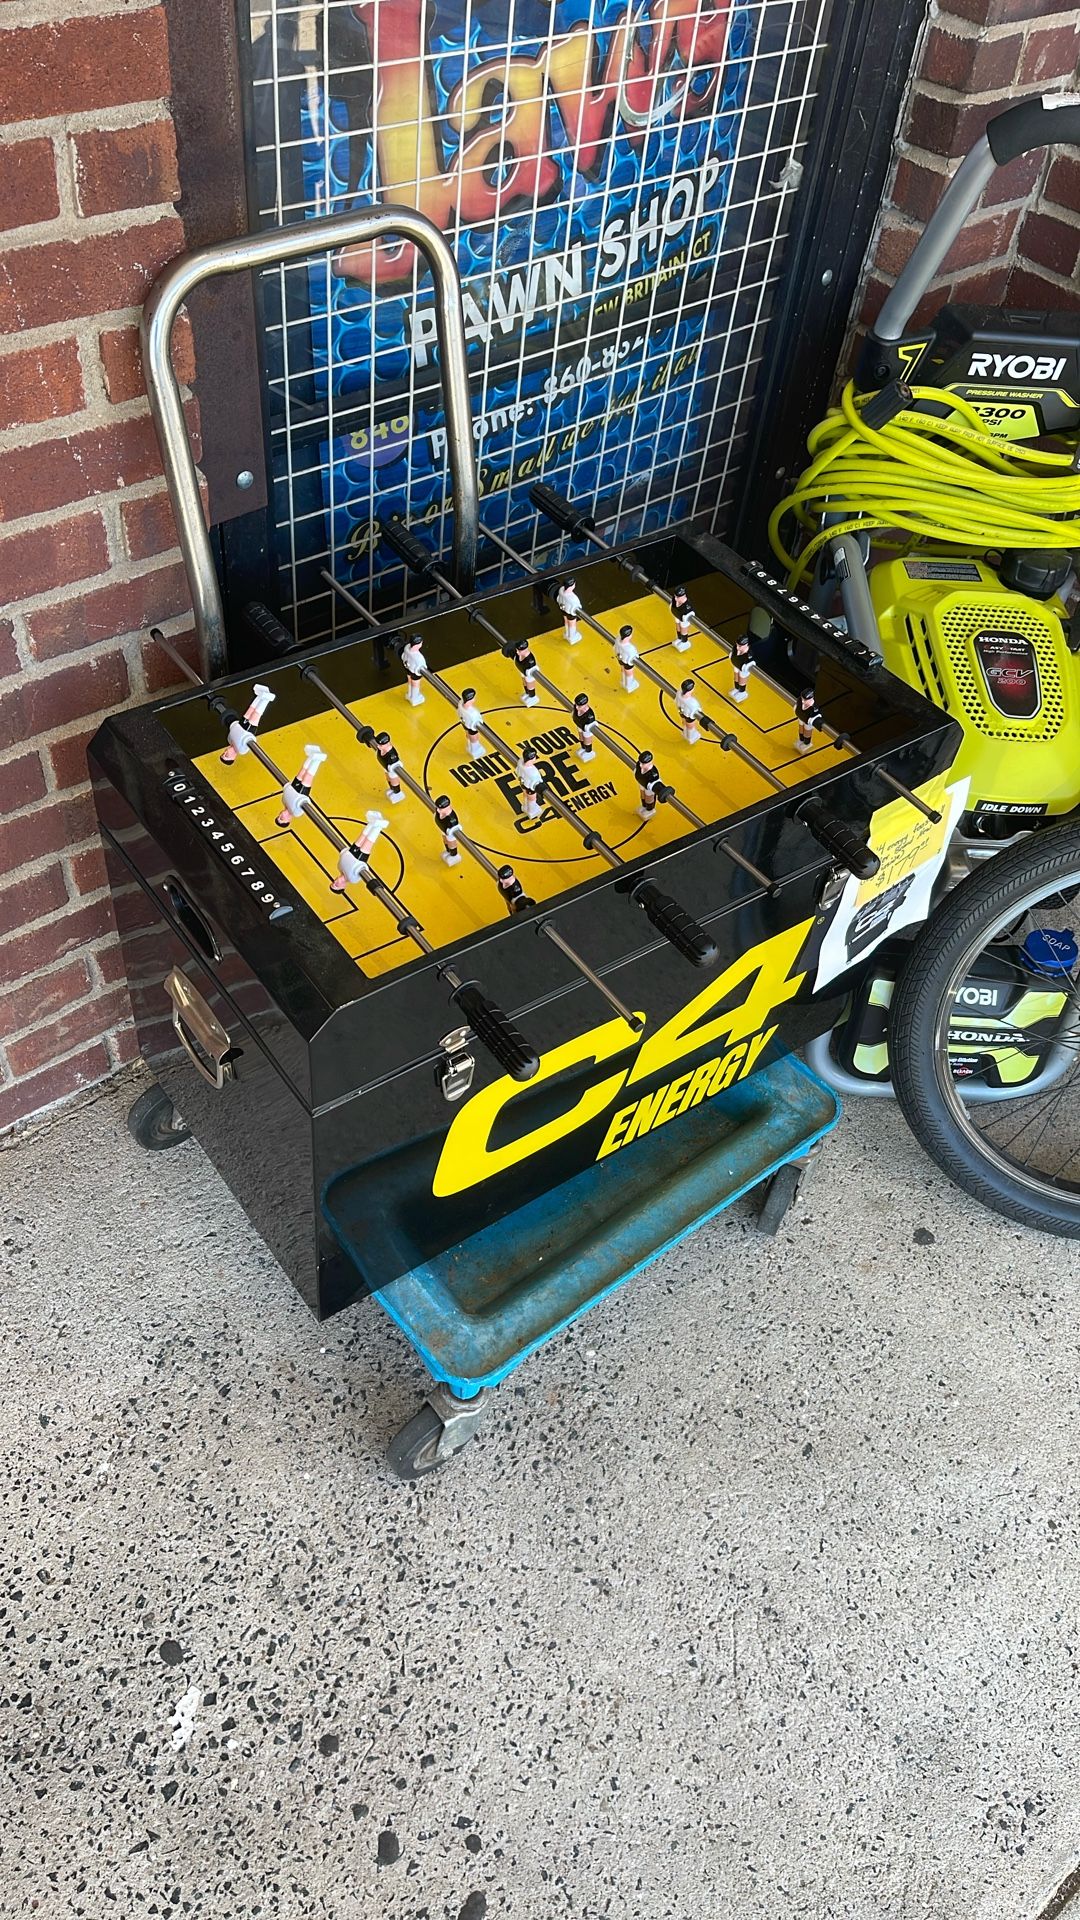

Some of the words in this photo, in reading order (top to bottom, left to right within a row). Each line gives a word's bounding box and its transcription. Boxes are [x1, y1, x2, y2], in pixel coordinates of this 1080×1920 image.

[692, 231, 711, 258] CT
[409, 242, 582, 369] PAWN
[600, 157, 720, 279] SHOP
[968, 352, 1067, 381] RYOBI
[966, 389, 1009, 398] PRESSURE
[1009, 390, 1044, 400] WASHER
[431, 398, 534, 459] Pone:
[978, 636, 1029, 645] HONDA
[986, 667, 1034, 679] GCV
[449, 751, 513, 788] IGNIT
[516, 726, 581, 756] YOUR
[494, 750, 591, 816] FRE
[513, 806, 562, 834] C4
[566, 781, 618, 815] ENERGY
[981, 803, 1008, 813] IDLE
[1009, 805, 1042, 814] DOWN
[173, 783, 187, 793] 0
[184, 795, 196, 804] 1
[191, 806, 205, 816] 2
[201, 818, 215, 828] 3
[211, 831, 225, 840] 4
[220, 842, 235, 853] 5
[230, 855, 245, 865] 6
[241, 867, 256, 877] 7
[251, 880, 265, 891] 8
[260, 893, 275, 904] 9
[1042, 934, 1071, 951] SOAP
[954, 986, 998, 1007] YOBI
[947, 1030, 1026, 1043] HONDA
[432, 915, 816, 1198] C4
[595, 1024, 779, 1162] ENERGY
